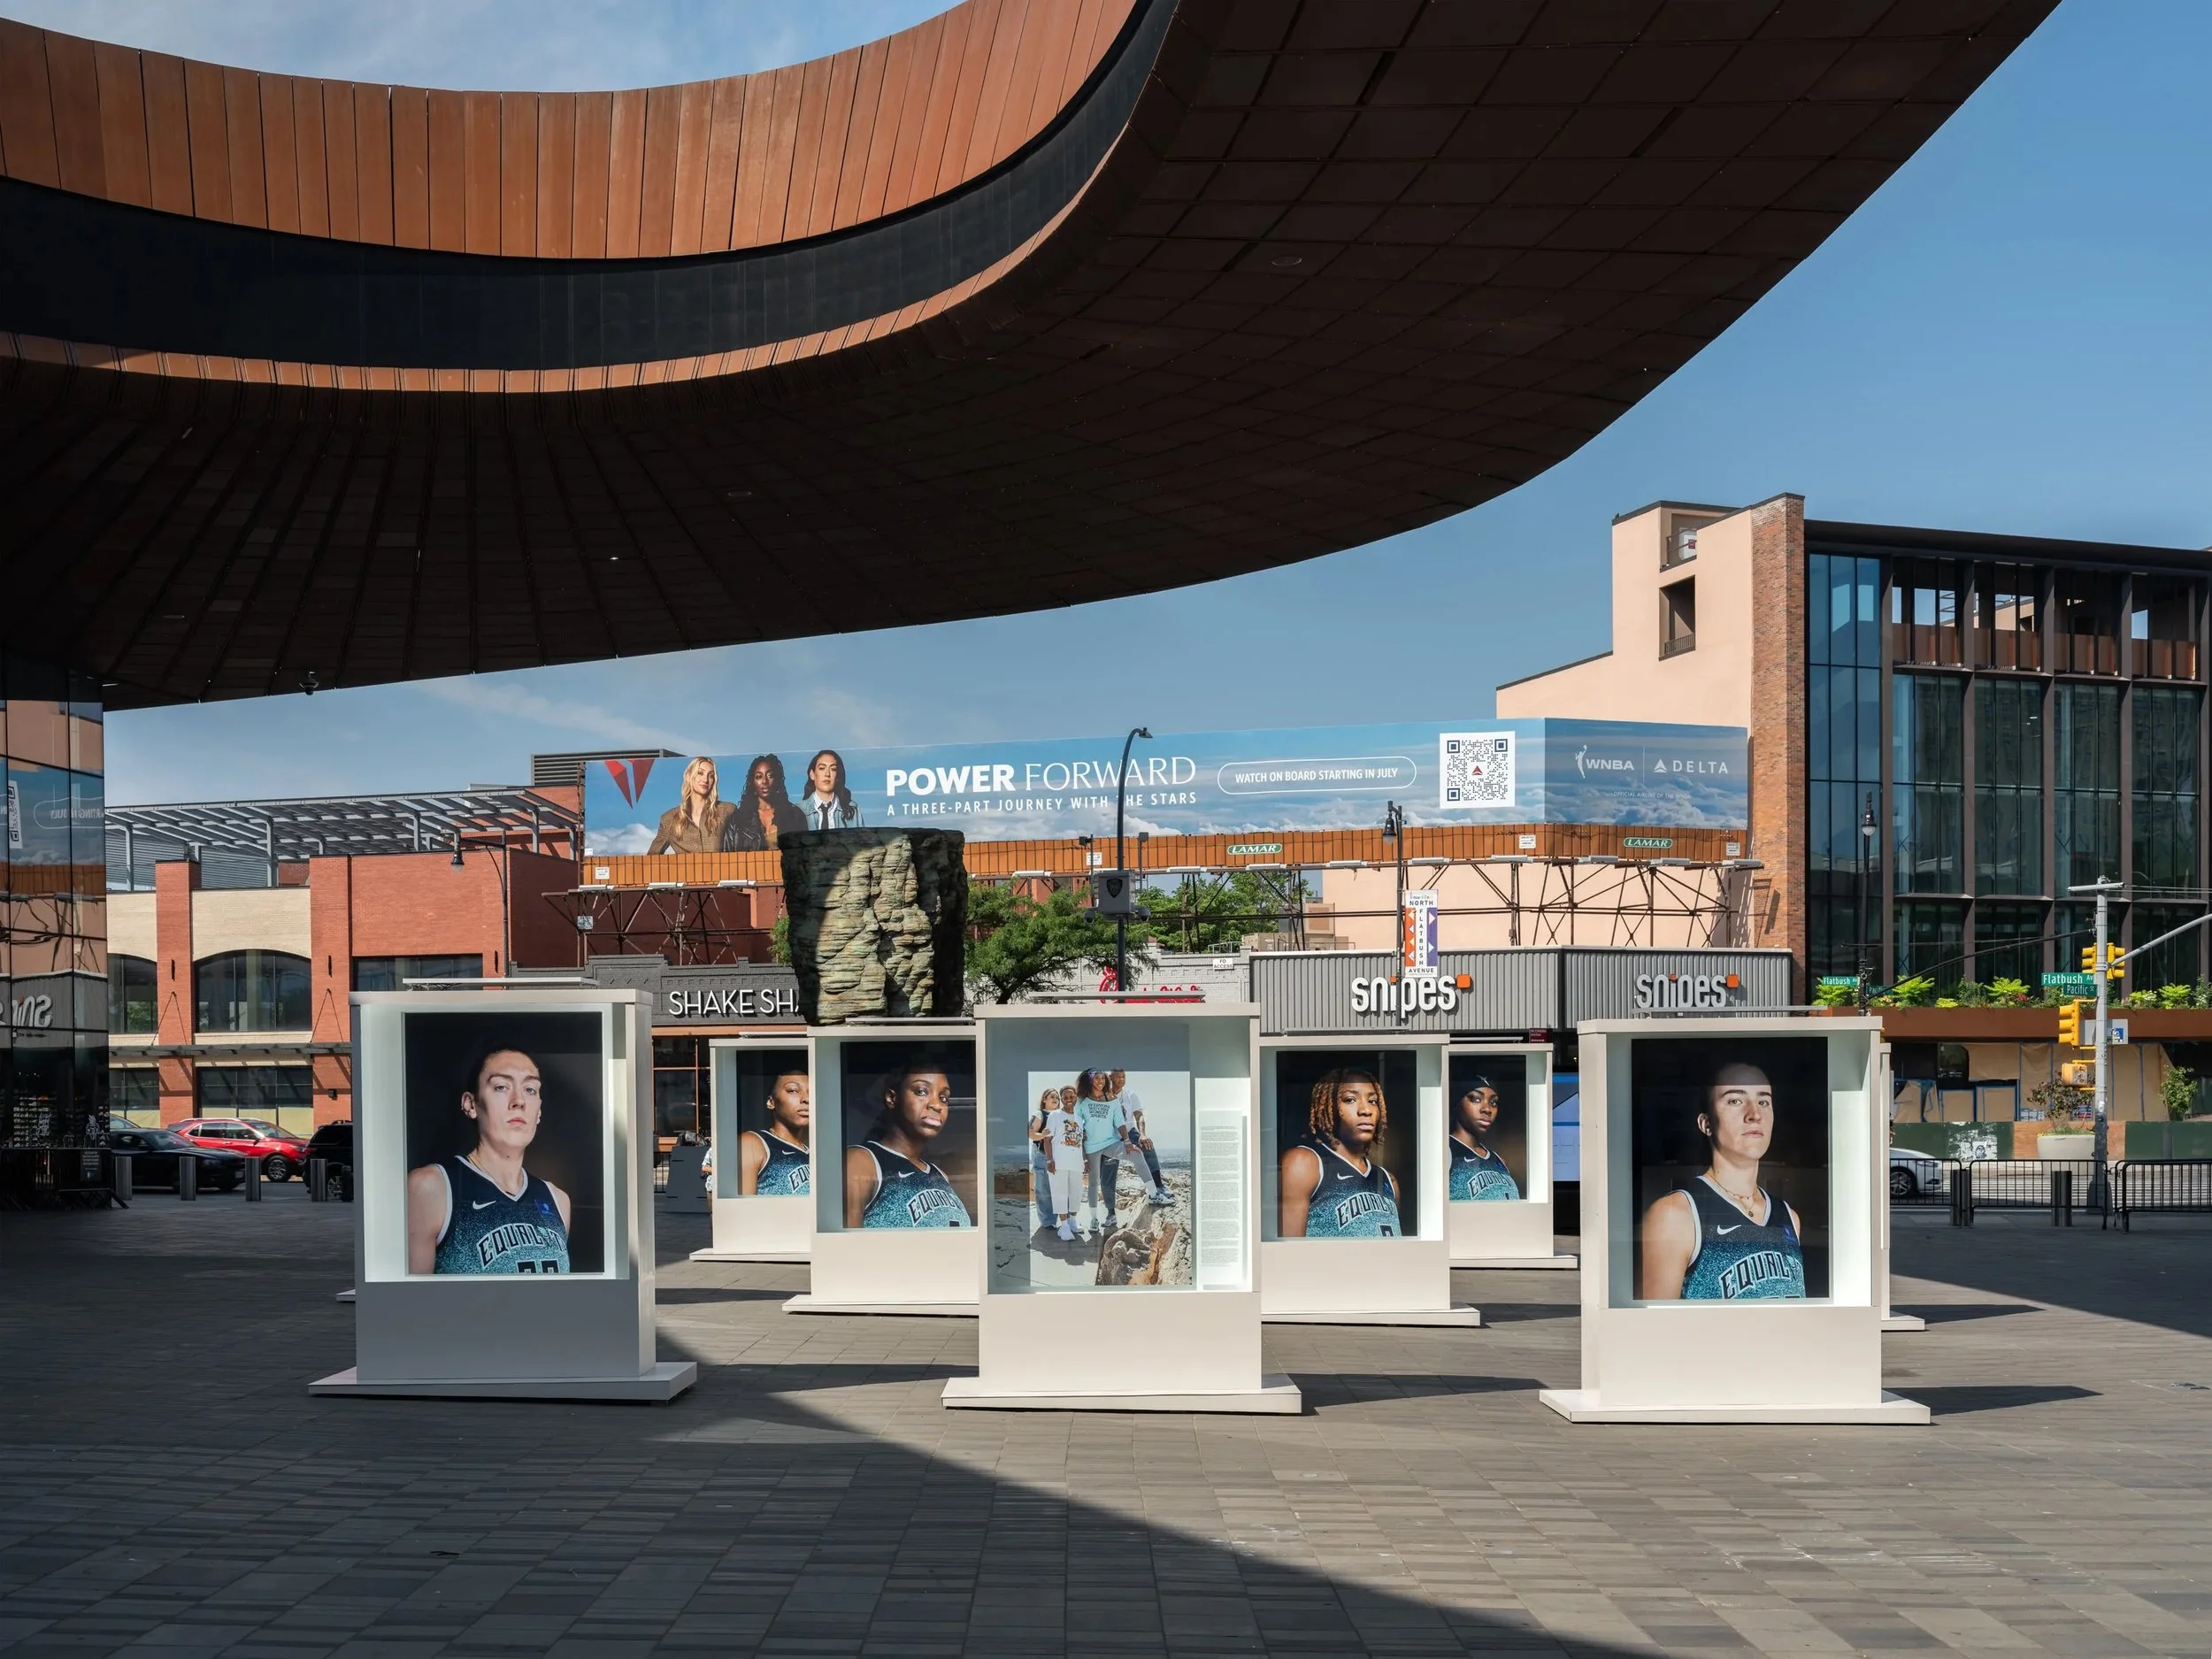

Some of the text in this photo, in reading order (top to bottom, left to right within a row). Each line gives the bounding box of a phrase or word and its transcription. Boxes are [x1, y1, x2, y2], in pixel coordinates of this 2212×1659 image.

[1586, 758, 1635, 771] WNBA
[1672, 759, 1729, 774] DELTA
[887, 757, 1196, 796] POWER FORWARD
[1235, 767, 1398, 784] WATCH ON BOARD STARTING IN JULY
[887, 792, 1196, 817] A THREE-PART JOURNEY WITH HE STARS
[1232, 844, 1277, 854] LAMAR
[2043, 973, 2083, 984] Flatbush
[1351, 975, 1456, 1018] snipes
[1637, 973, 1726, 1008] snipes
[2067, 985, 2088, 995] Pacific
[669, 988, 799, 1016] SHAKE SH
